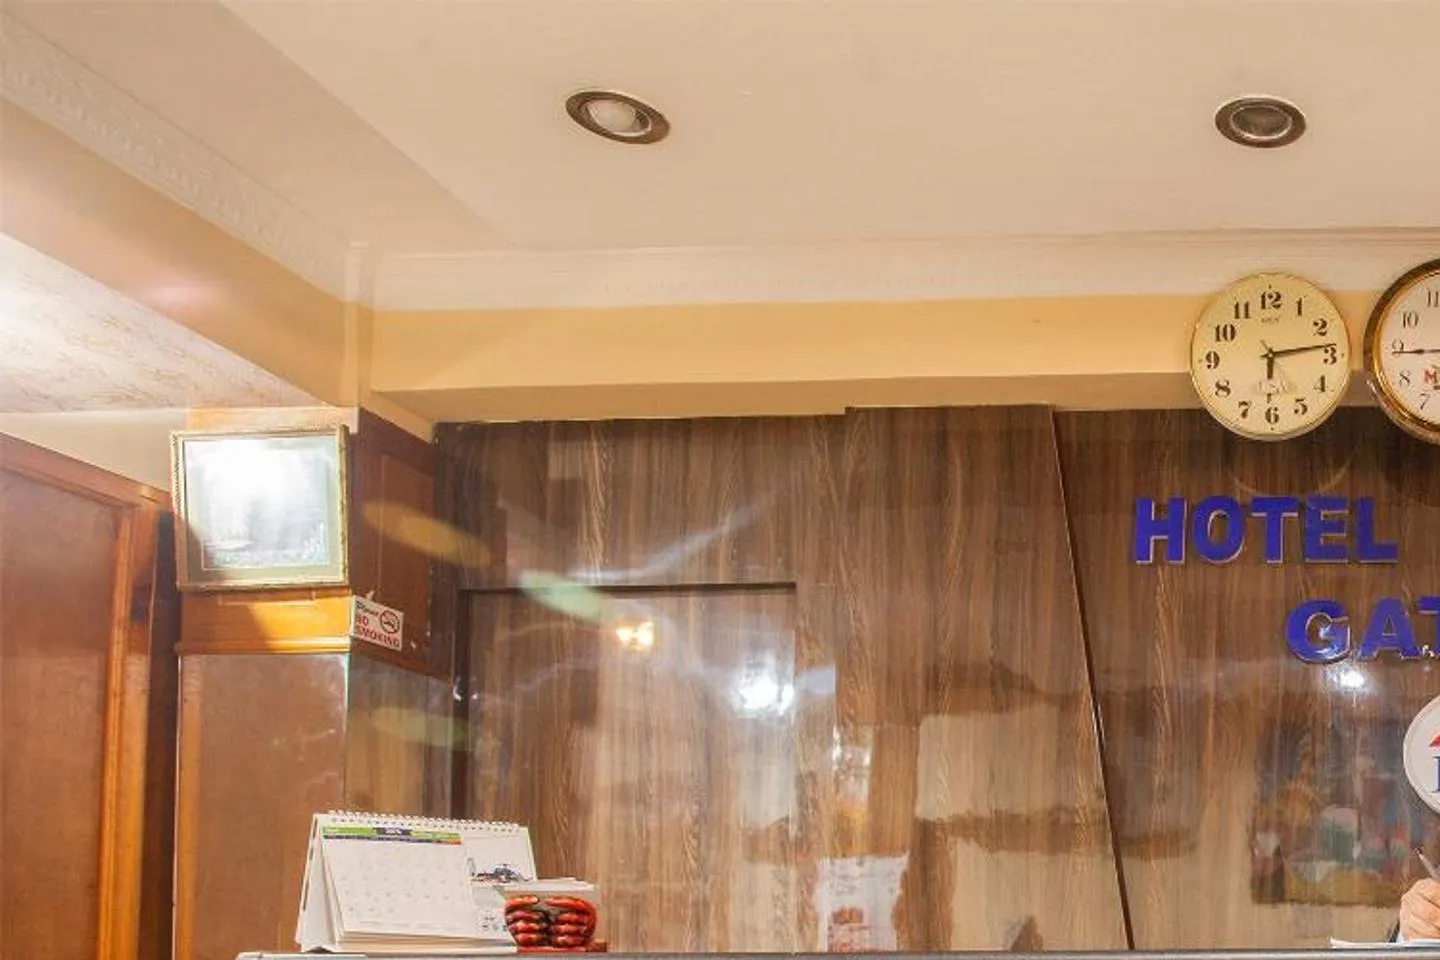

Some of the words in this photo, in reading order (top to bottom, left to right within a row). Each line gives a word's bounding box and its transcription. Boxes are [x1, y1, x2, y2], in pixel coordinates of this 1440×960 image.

[1260, 291, 1283, 310] 12
[1296, 298, 1303, 316] 1
[1427, 290, 1439, 308] 11
[1234, 301, 1250, 319] 11
[1313, 318, 1328, 336] 2
[1402, 311, 1419, 329] 10
[1215, 324, 1236, 342] 10
[1205, 351, 1220, 369] 9
[1323, 345, 1337, 365] 3
[1314, 375, 1326, 393] 4
[1398, 369, 1412, 387] 8
[1215, 379, 1231, 397] 8
[1238, 400, 1251, 419] 7
[1294, 397, 1308, 416] 5
[1419, 392, 1431, 411] 7
[1265, 406, 1279, 424] 6
[1135, 495, 1399, 565] HOTEL
